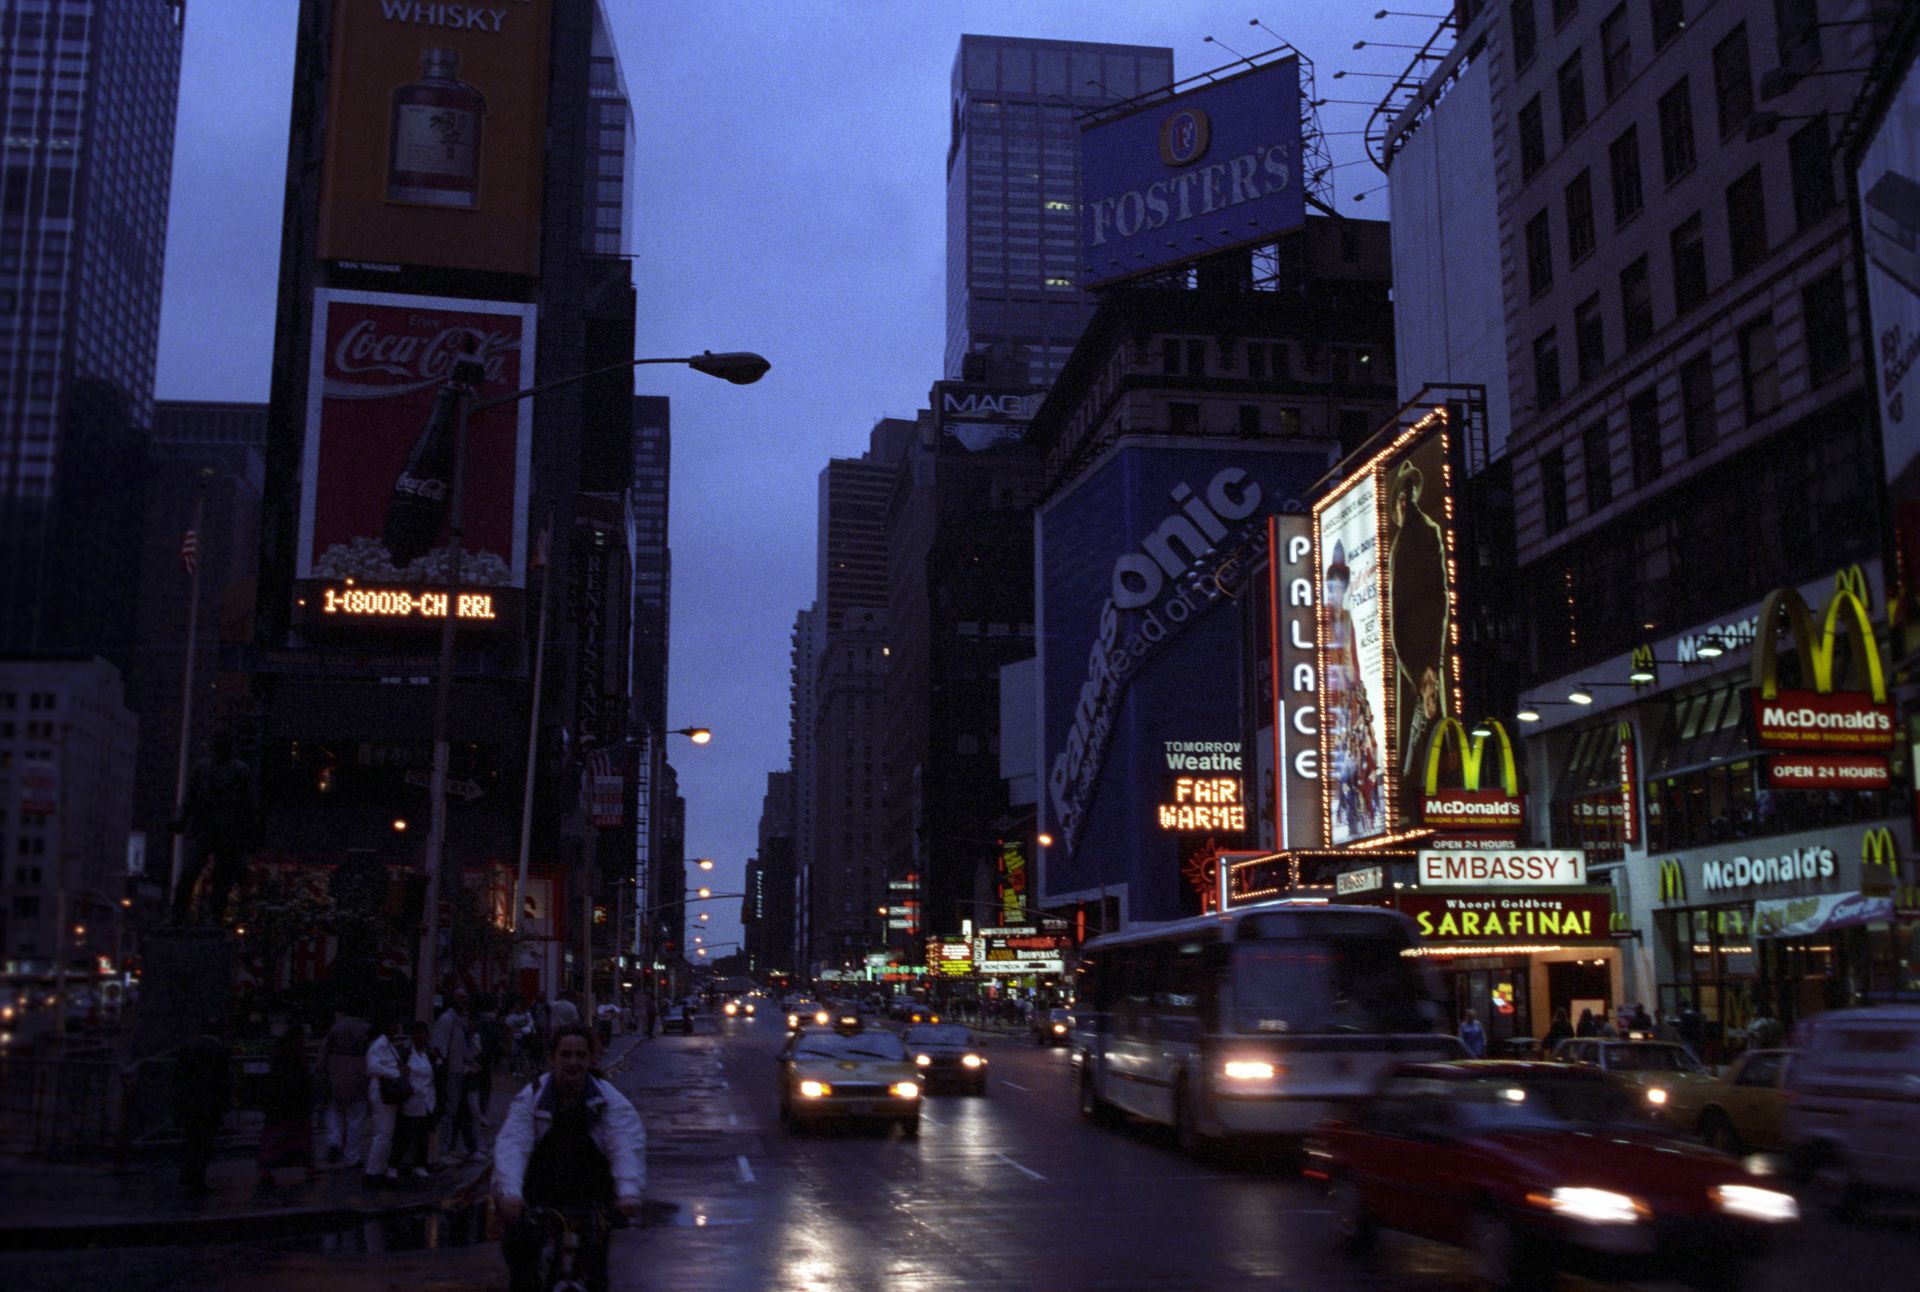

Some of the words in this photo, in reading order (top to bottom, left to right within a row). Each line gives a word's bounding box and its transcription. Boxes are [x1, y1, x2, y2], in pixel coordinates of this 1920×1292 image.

[380, 0, 508, 33] WHISKY
[1091, 143, 1291, 248] FOSTER'S
[1048, 466, 1263, 829] Panasonic
[1289, 535, 1320, 780] PALACE
[1762, 707, 1891, 730] McDonald's
[1773, 765, 1814, 779] OPEN
[1817, 766, 1835, 779] 24
[1839, 767, 1888, 780] HOURS
[1175, 777, 1237, 804] FAIR
[1425, 800, 1521, 817] McDonald's
[1432, 840, 1463, 850] OPEN
[1464, 840, 1478, 850] 24
[1480, 840, 1517, 850] HOURS
[1427, 856, 1559, 880] EMBASSY
[1568, 856, 1580, 880] 1
[1703, 845, 1835, 891] McDonald's
[1446, 899, 1496, 911] Whoopi
[1501, 899, 1563, 911] Goldberg
[1416, 910, 1592, 937] SARAFINA!
